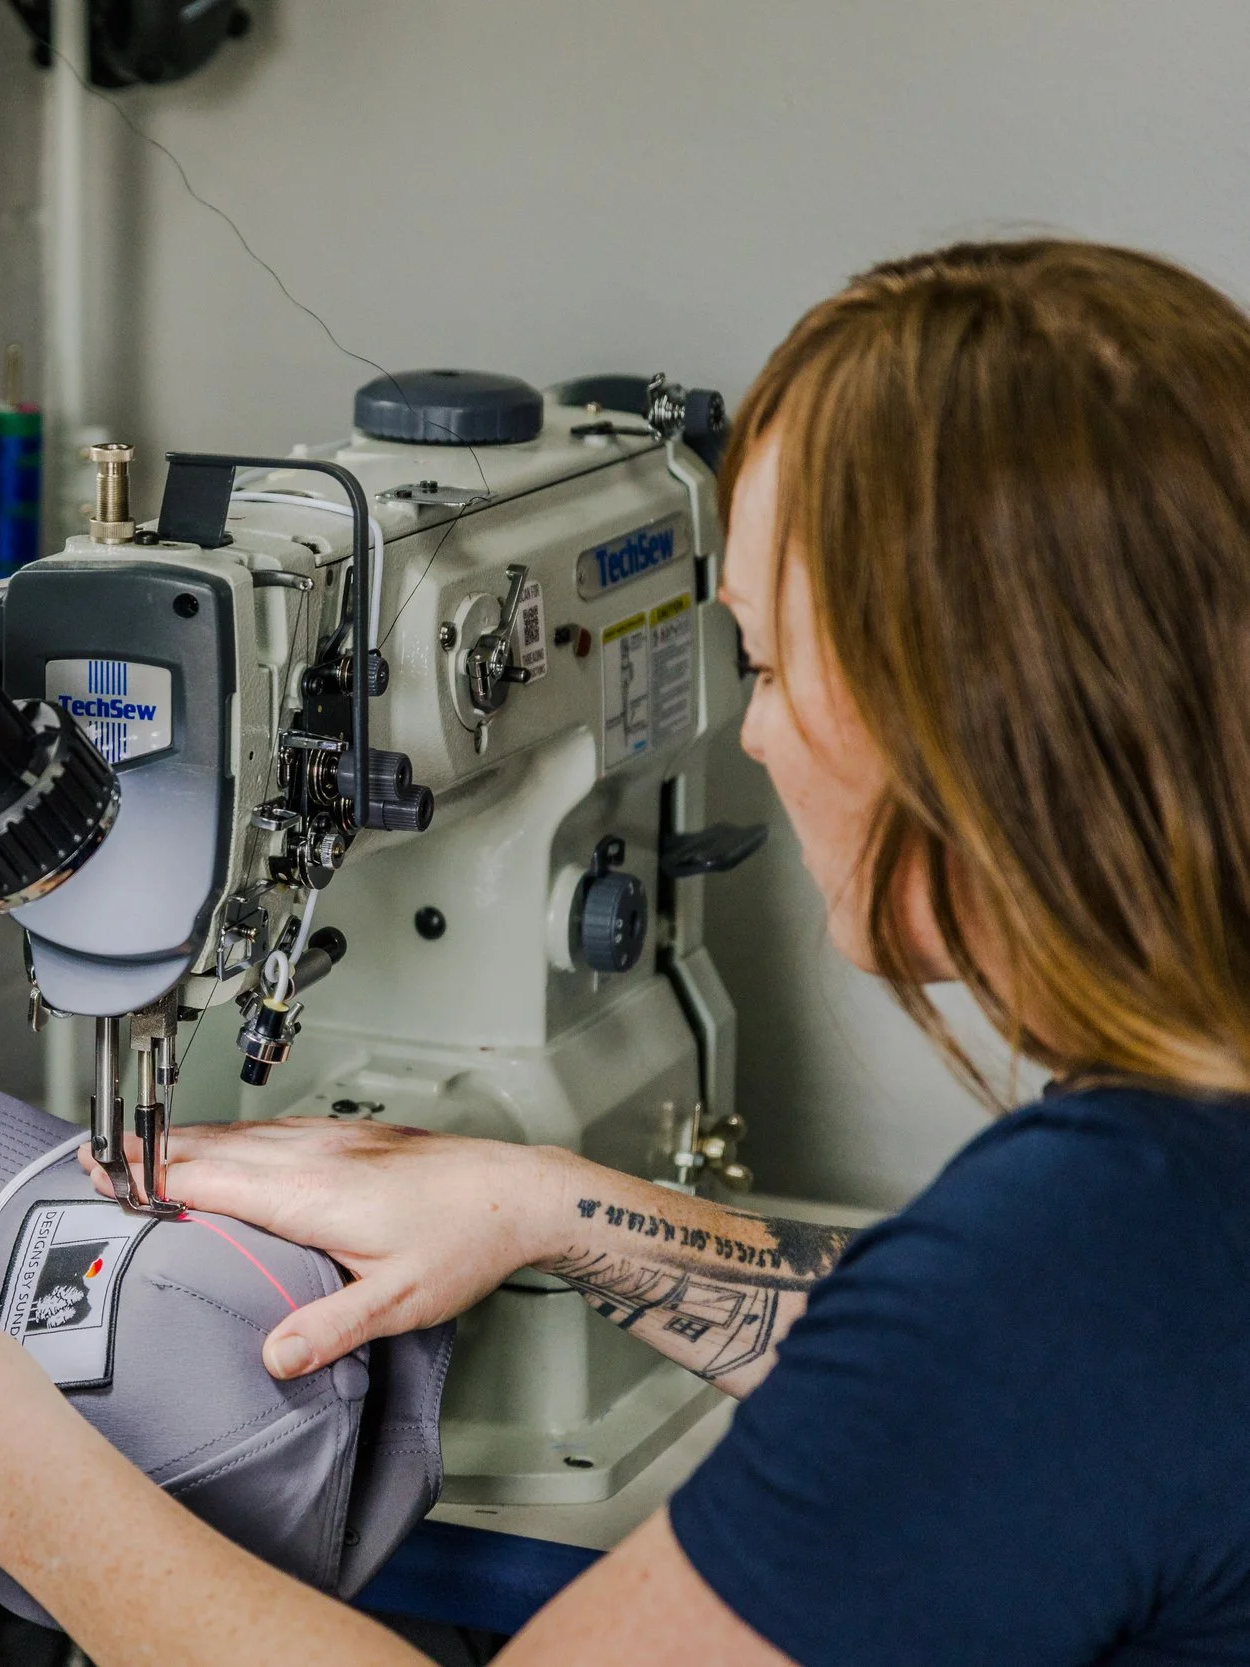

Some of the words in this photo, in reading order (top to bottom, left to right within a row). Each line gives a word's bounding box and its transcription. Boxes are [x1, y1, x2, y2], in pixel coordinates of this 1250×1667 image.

[592, 527, 674, 588] TechSew
[58, 695, 157, 721] TechSew
[28, 1211, 57, 1270] DESIGNS
[23, 1272, 35, 1290] BY
[10, 1293, 30, 1340] SUND
